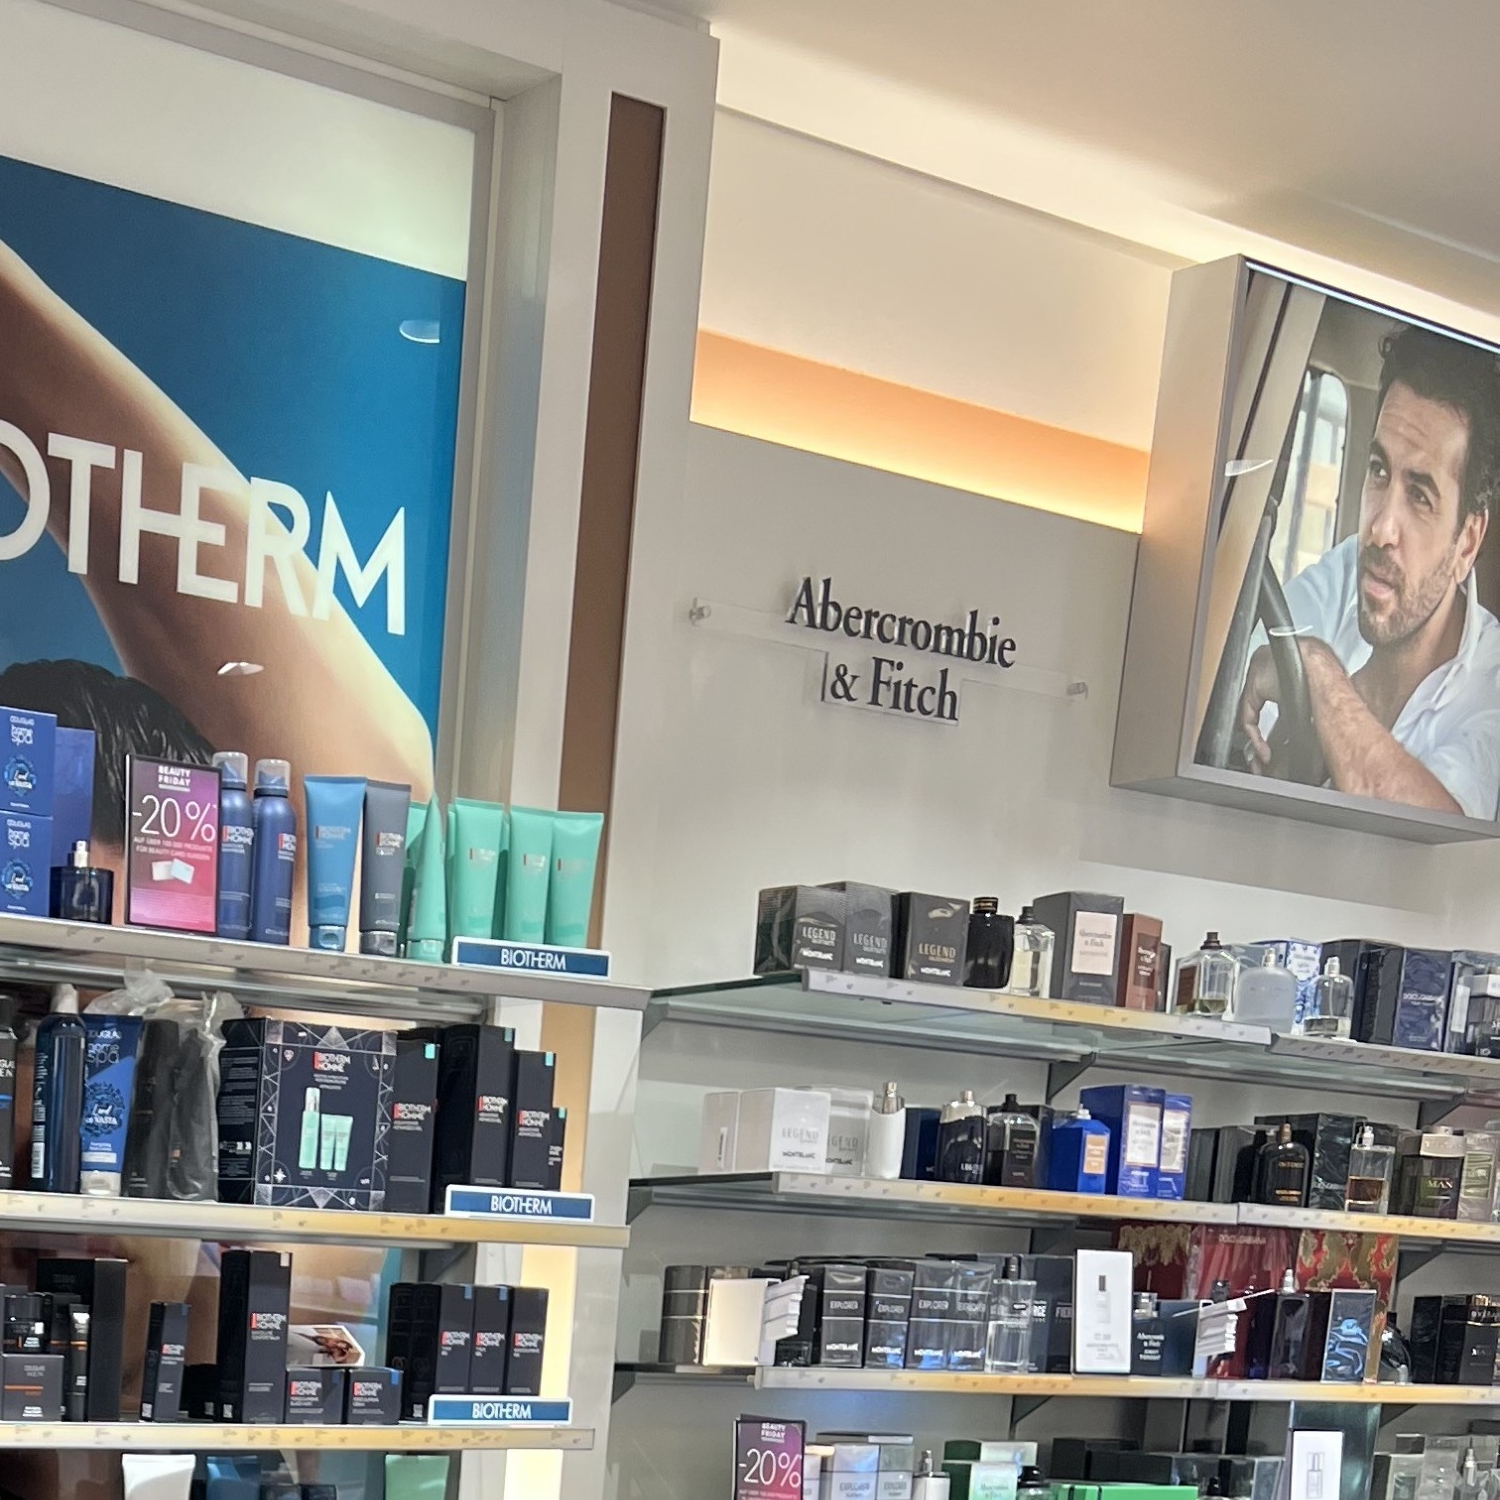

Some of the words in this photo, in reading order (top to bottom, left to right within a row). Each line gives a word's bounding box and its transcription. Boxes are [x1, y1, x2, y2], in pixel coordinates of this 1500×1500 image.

[785, 576, 1017, 668] Abercrombie
[830, 663, 861, 702] &
[867, 656, 959, 722] Fitch
[158, 765, 191, 777] BEAUTY
[158, 775, 191, 787] FRIDAY
[802, 926, 836, 941] LEGEND
[853, 932, 888, 948] LEGEND
[919, 942, 956, 959] LEGEND
[500, 948, 567, 972] BIOTHERM
[782, 1128, 819, 1140] LEGEND
[490, 1195, 553, 1216] BIOTHERM
[472, 1402, 532, 1420] BIOTHERM
